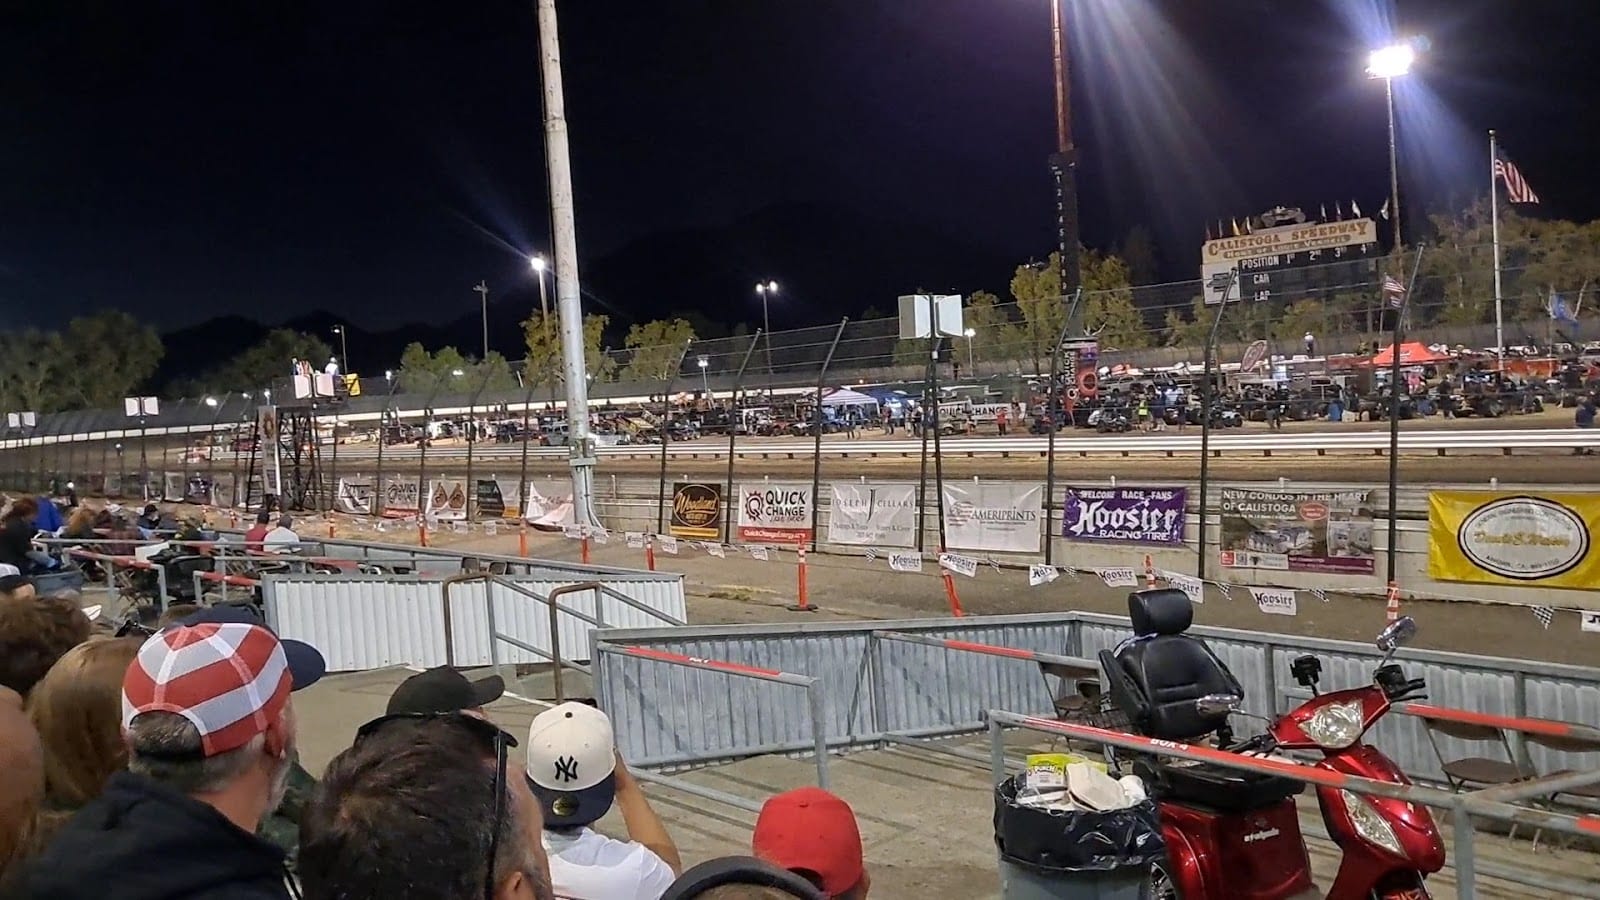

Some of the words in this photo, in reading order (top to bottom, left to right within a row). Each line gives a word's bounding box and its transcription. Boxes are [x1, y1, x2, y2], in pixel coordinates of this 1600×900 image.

[1208, 234, 1281, 256] CALISTOGA
[1292, 221, 1369, 241] SPEEDWAY
[1242, 255, 1279, 269] POSITION
[1253, 273, 1270, 285] CAR
[1254, 290, 1270, 301] LAP
[766, 490, 806, 505] QUICK
[1080, 490, 1116, 499] WELCOME
[1121, 490, 1144, 499] RACE
[1150, 491, 1173, 500] FANS
[1223, 490, 1248, 500] NEW
[1249, 491, 1295, 500] CONDOS
[1296, 493, 1308, 501] IN
[1311, 492, 1332, 501] THE
[1334, 492, 1369, 501] HEART
[877, 499, 913, 508] CELLARS
[1223, 502, 1236, 511] OF
[1238, 503, 1296, 513] CALISTOGA
[766, 506, 805, 516] CHANGE
[1069, 499, 1178, 536] Hoosier
[1100, 529, 1142, 539] RACING
[1143, 531, 1170, 541] TIRE
[1256, 592, 1293, 606] Hoosier
[555, 755, 578, 782] NY
